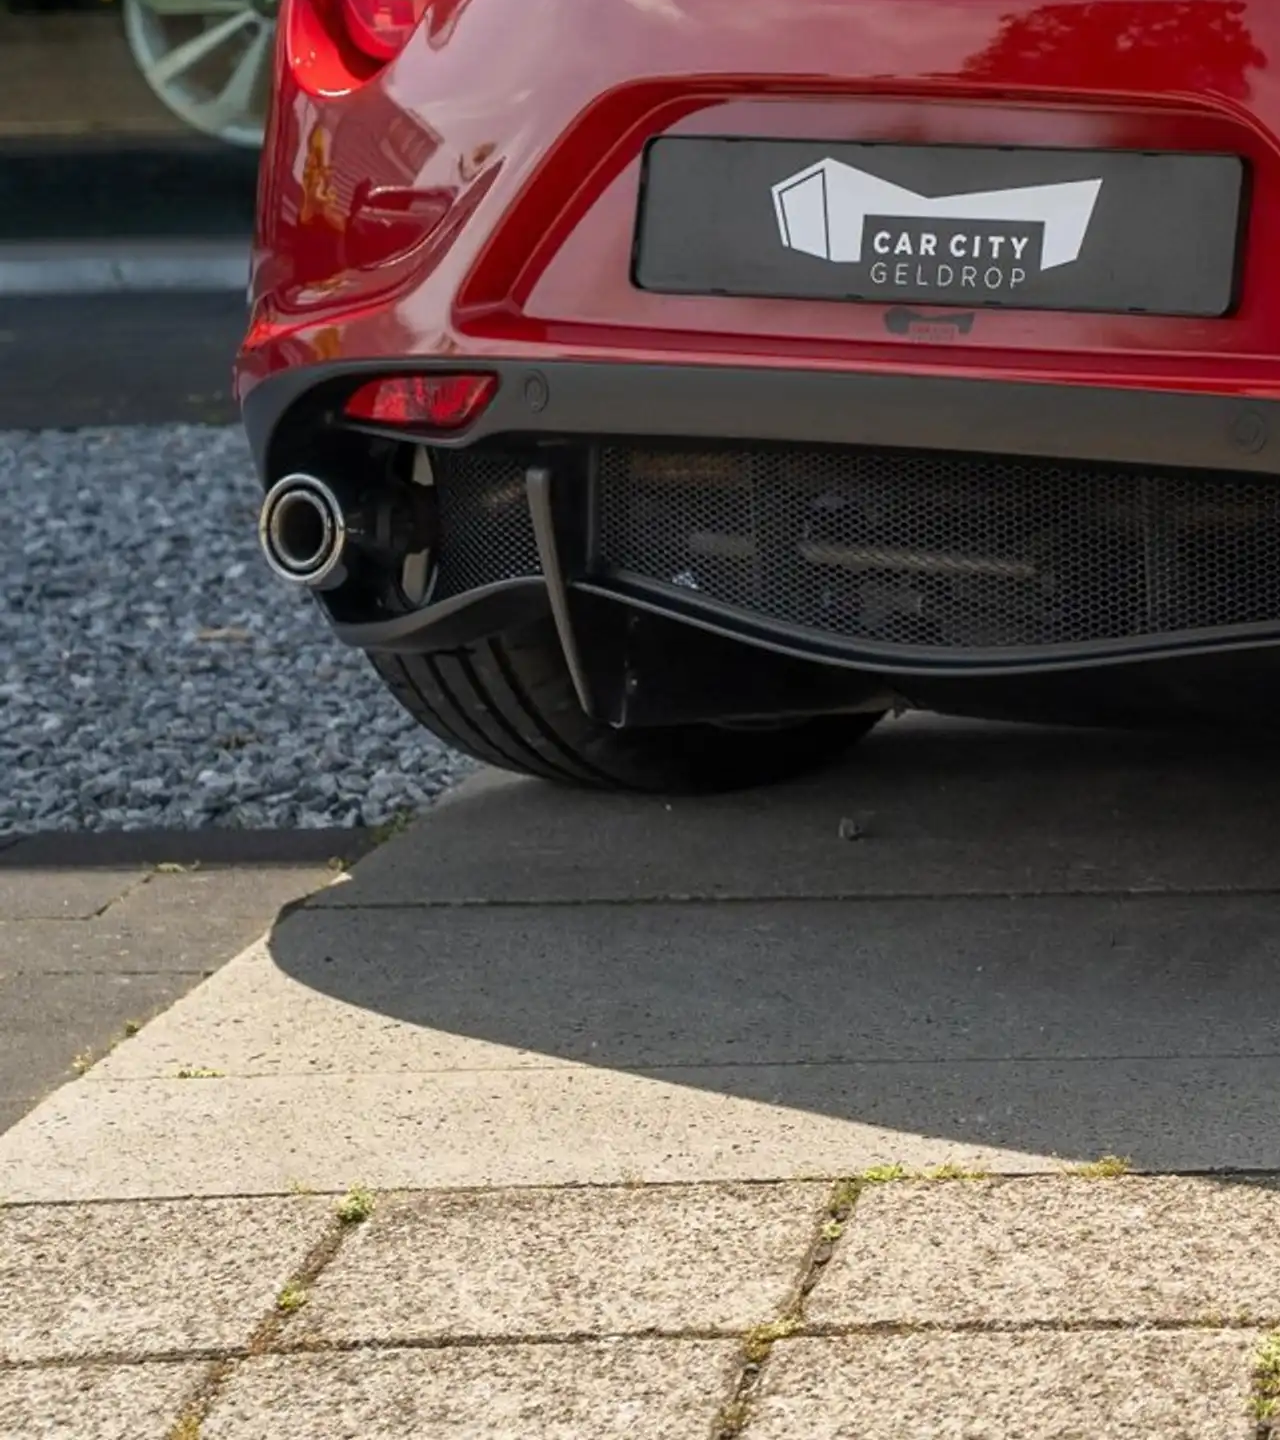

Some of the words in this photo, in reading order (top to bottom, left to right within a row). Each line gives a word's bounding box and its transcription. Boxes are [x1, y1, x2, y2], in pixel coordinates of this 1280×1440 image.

[873, 230, 938, 256] CAR
[949, 234, 1029, 260] CITY
[870, 262, 1026, 289] GELDROP
